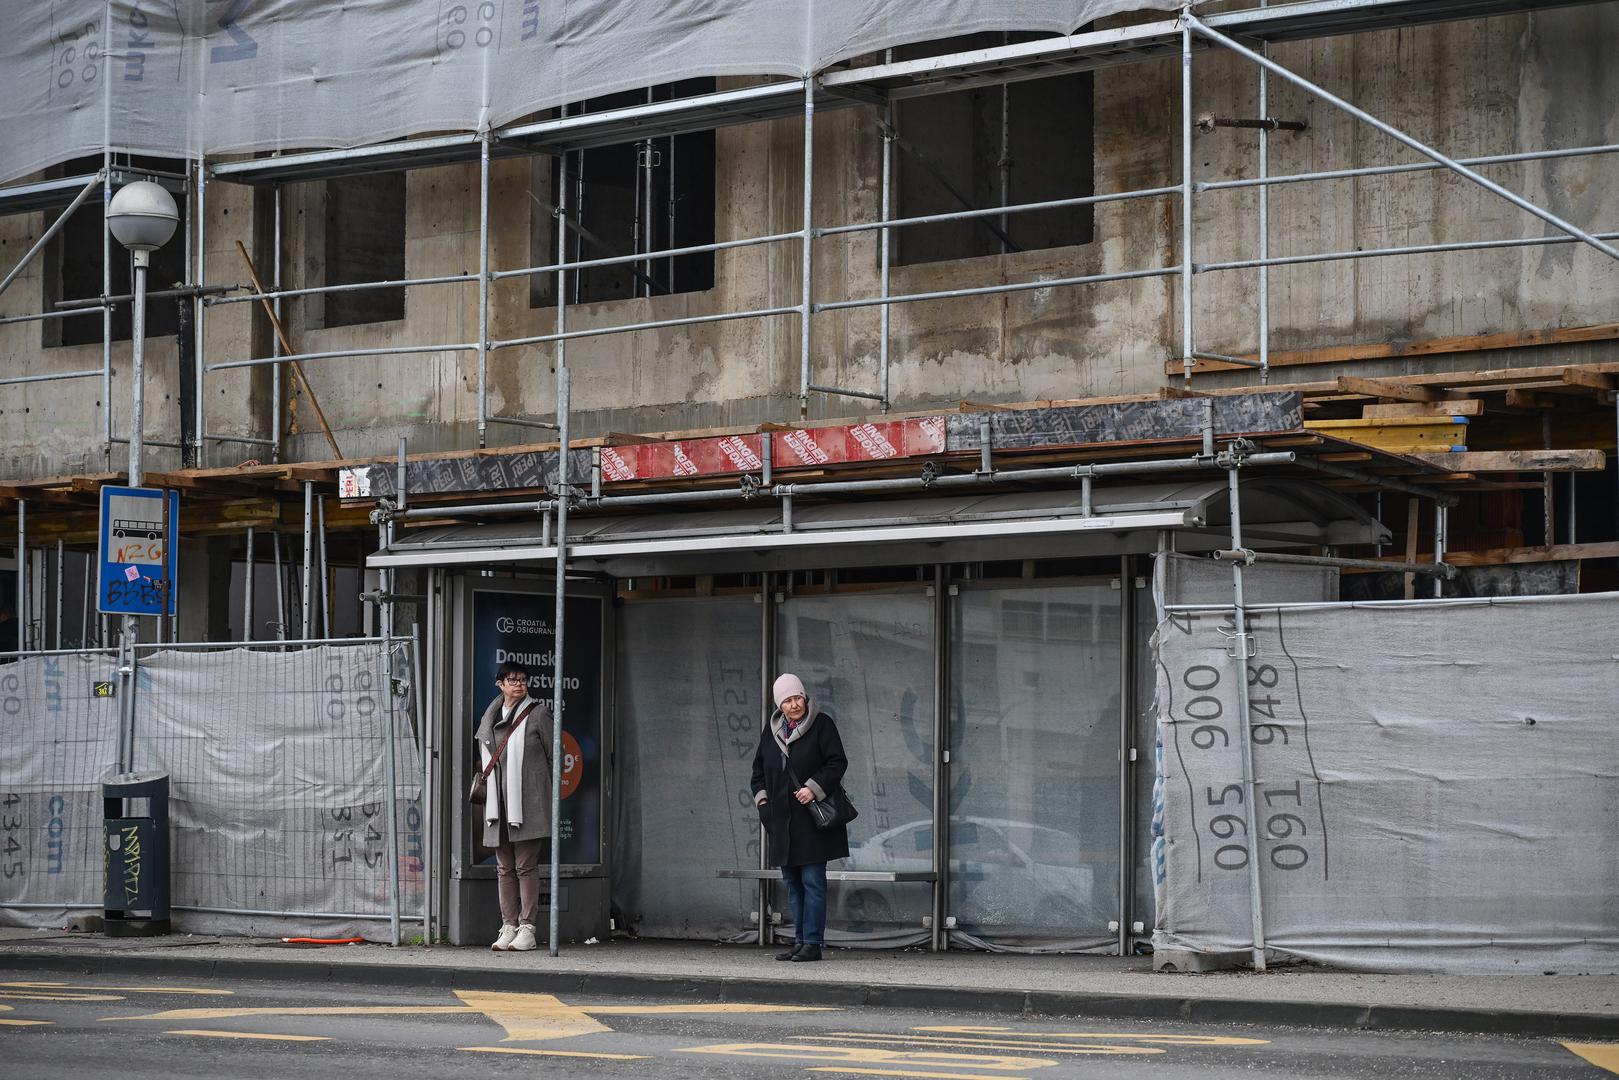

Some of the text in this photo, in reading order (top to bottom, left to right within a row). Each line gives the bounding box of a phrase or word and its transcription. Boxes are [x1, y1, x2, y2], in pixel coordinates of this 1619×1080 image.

[432, 466, 456, 492] PERI
[516, 618, 547, 627] CROATIA
[516, 626, 557, 635] OSIGURANJ
[495, 648, 557, 667] Dopunsk
[1183, 664, 1250, 870] 095 900
[1247, 664, 1309, 870] 091 948
[2, 793, 24, 880] 4345
[47, 794, 64, 875] com
